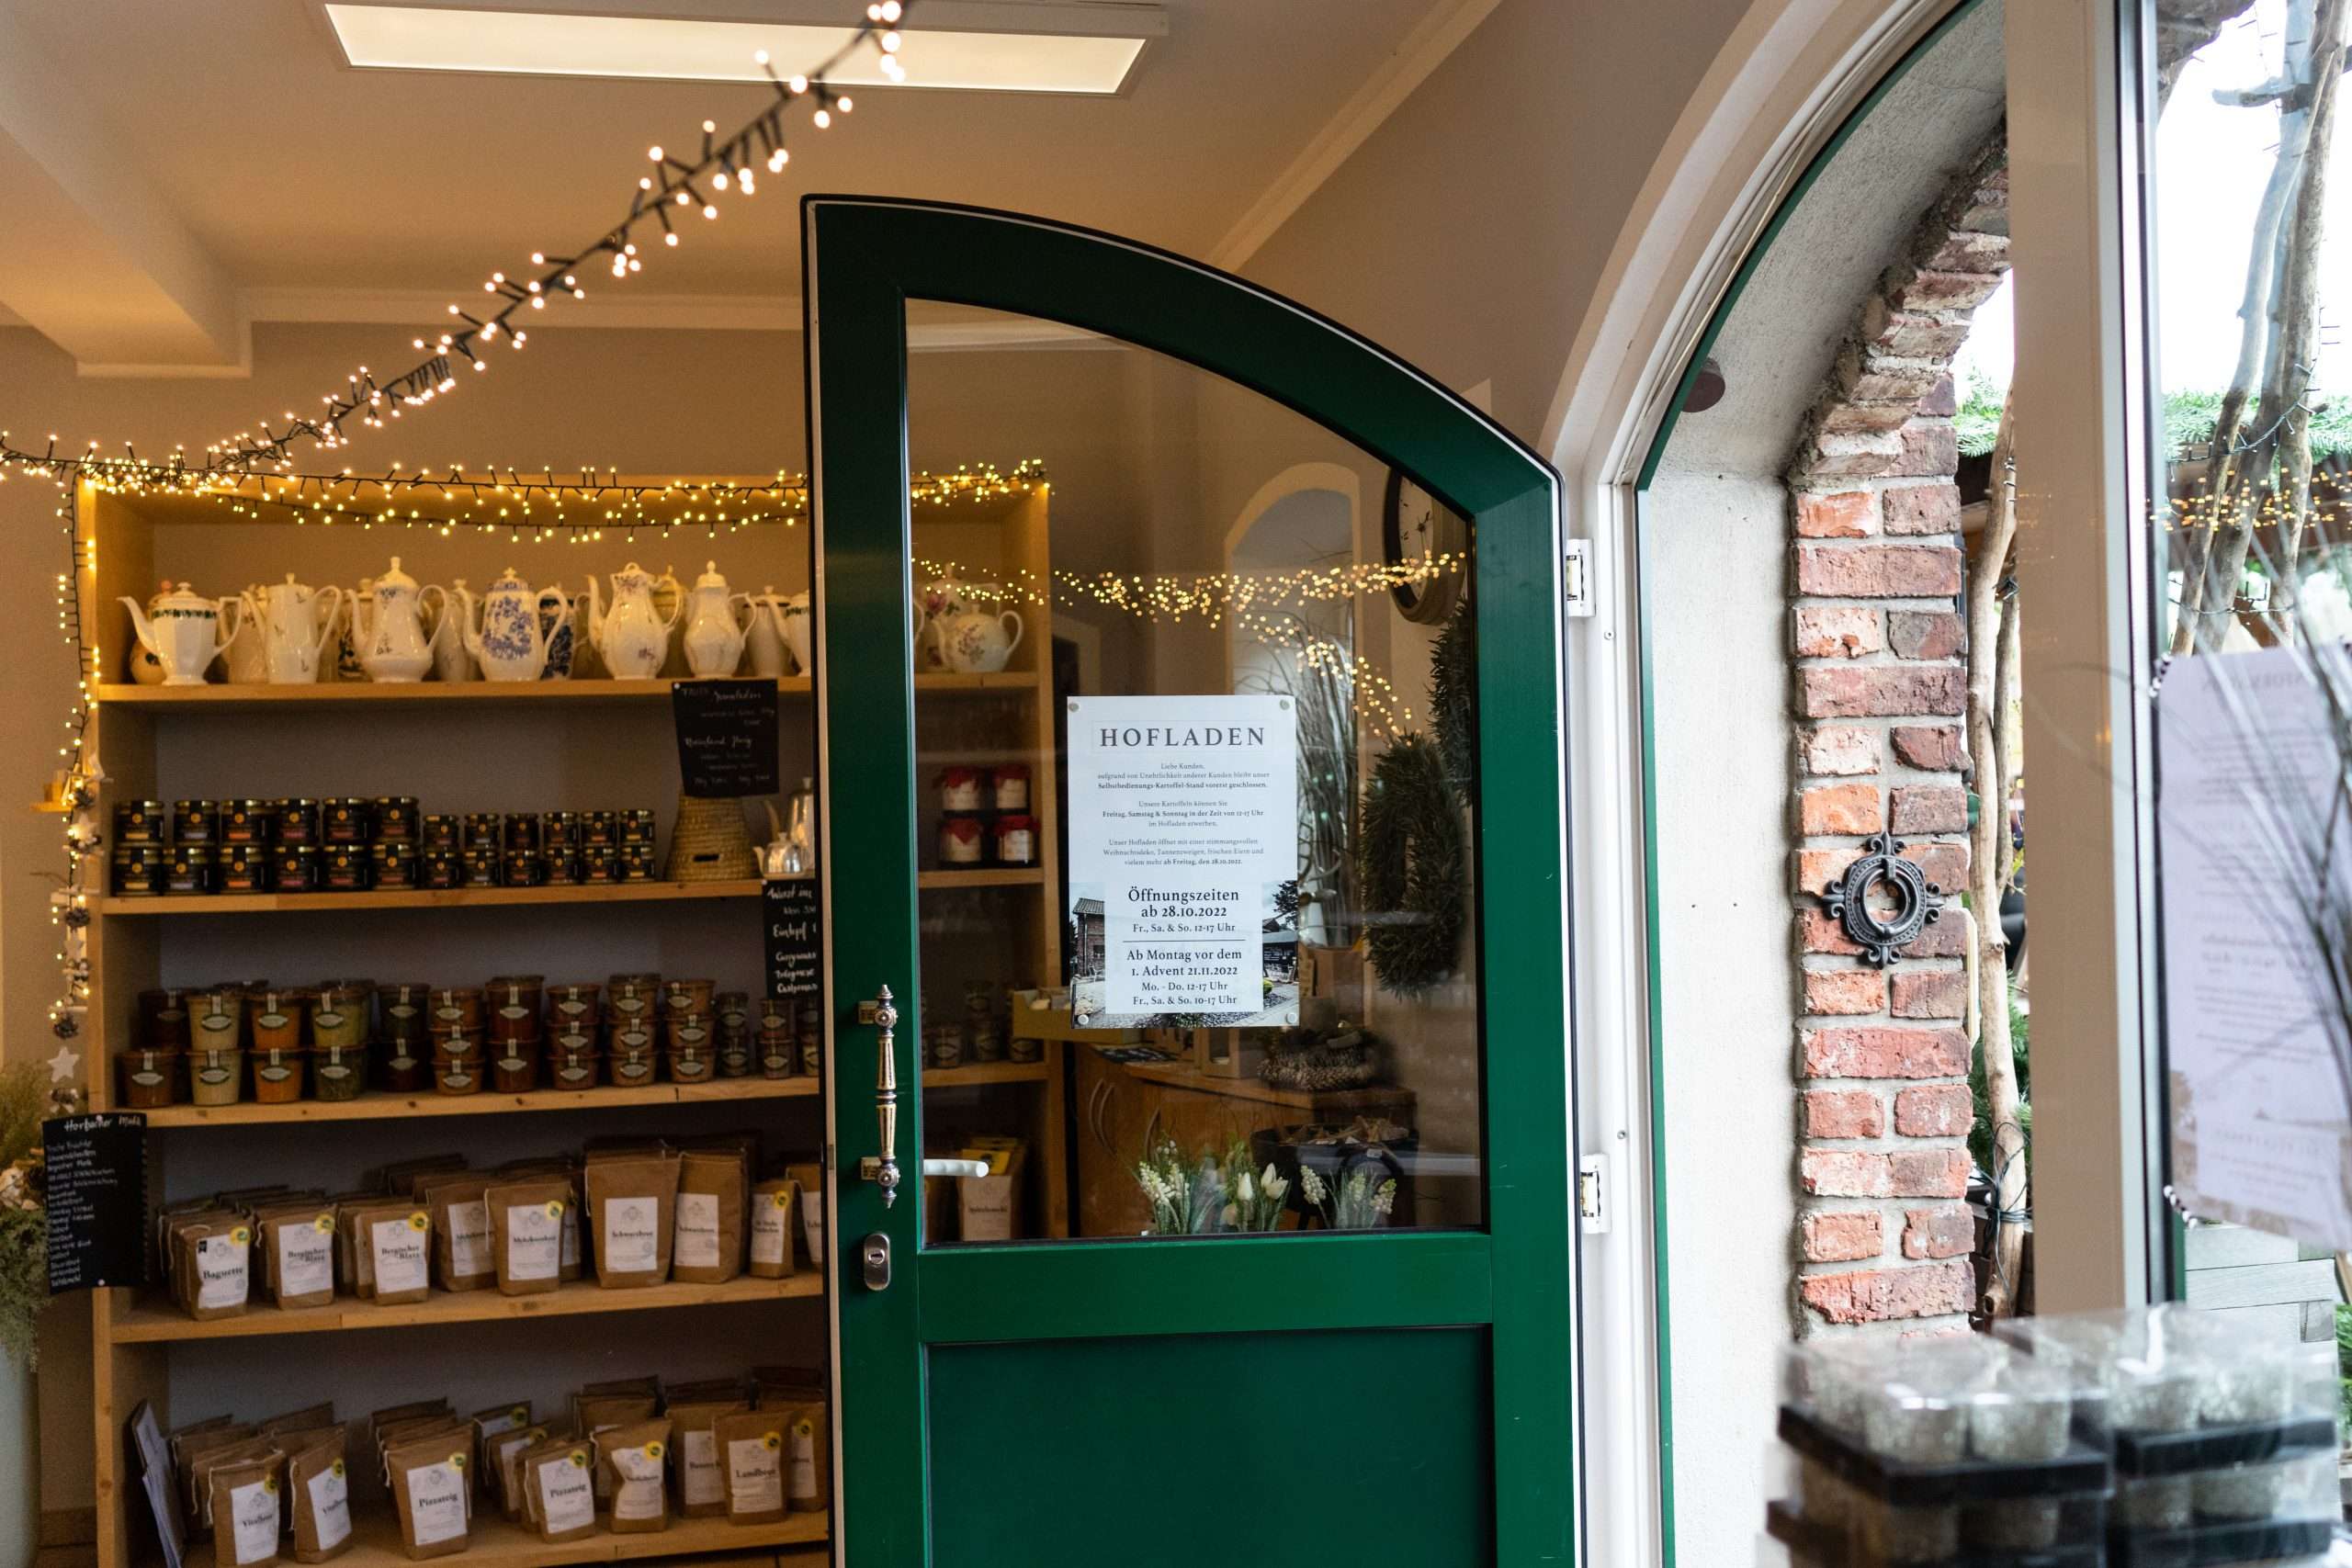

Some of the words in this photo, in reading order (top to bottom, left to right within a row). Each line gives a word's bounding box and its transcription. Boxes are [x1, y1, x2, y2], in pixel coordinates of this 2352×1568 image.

[1100, 727, 1265, 747] HOFLADEN
[1160, 762, 1178, 771] Liebe
[1097, 773, 1125, 781] aufgrund
[1098, 781, 1204, 790] Selbstbedienungs-Kartoffel-Stand
[1228, 781, 1267, 789] geschlossen.
[1102, 810, 1126, 819] Freitag,
[1127, 810, 1155, 818] Samstag
[1162, 810, 1188, 818] Sonntag
[1128, 838, 1157, 846] Hofladen
[1206, 838, 1258, 846] stimmungsvollen
[1103, 848, 1156, 856] Weihnachtsdeko,
[1124, 856, 1145, 864] vielem
[1172, 857, 1196, 866] Freitag,
[1128, 886, 1239, 905] Öffnungszeiten
[1141, 904, 1158, 918] ab
[1161, 905, 1227, 918] 28.10.2022
[1133, 923, 1148, 934] Fr.,
[1150, 923, 1165, 932] Sa.
[1167, 923, 1175, 932] &
[1177, 923, 1192, 932] So.
[1194, 924, 1215, 934] 12-17
[1217, 922, 1236, 932] Uhr
[1126, 949, 1144, 961] Ab
[1147, 949, 1192, 963] Montag
[1194, 951, 1215, 960] vor
[1216, 948, 1242, 960] dem
[1131, 968, 1139, 976] 1.
[1142, 964, 1183, 976] Advent
[1187, 966, 1238, 976] 21.11.2022
[1141, 982, 1159, 992] Mo.
[1168, 981, 1184, 991] Do.
[1187, 983, 1207, 992] 12-17
[1209, 980, 1227, 991] Uhr
[1133, 996, 1148, 1006] Fr.,
[1150, 996, 1165, 1006] Sa.
[1167, 996, 1175, 1005] &
[1177, 996, 1192, 1005] So.
[1194, 997, 1216, 1006] 10-17
[1218, 995, 1237, 1005] Uhr
[203, 1267, 243, 1280] Baguette
[550, 1483, 587, 1498] Pizzateig
[419, 1492, 458, 1507] Pizzateig
